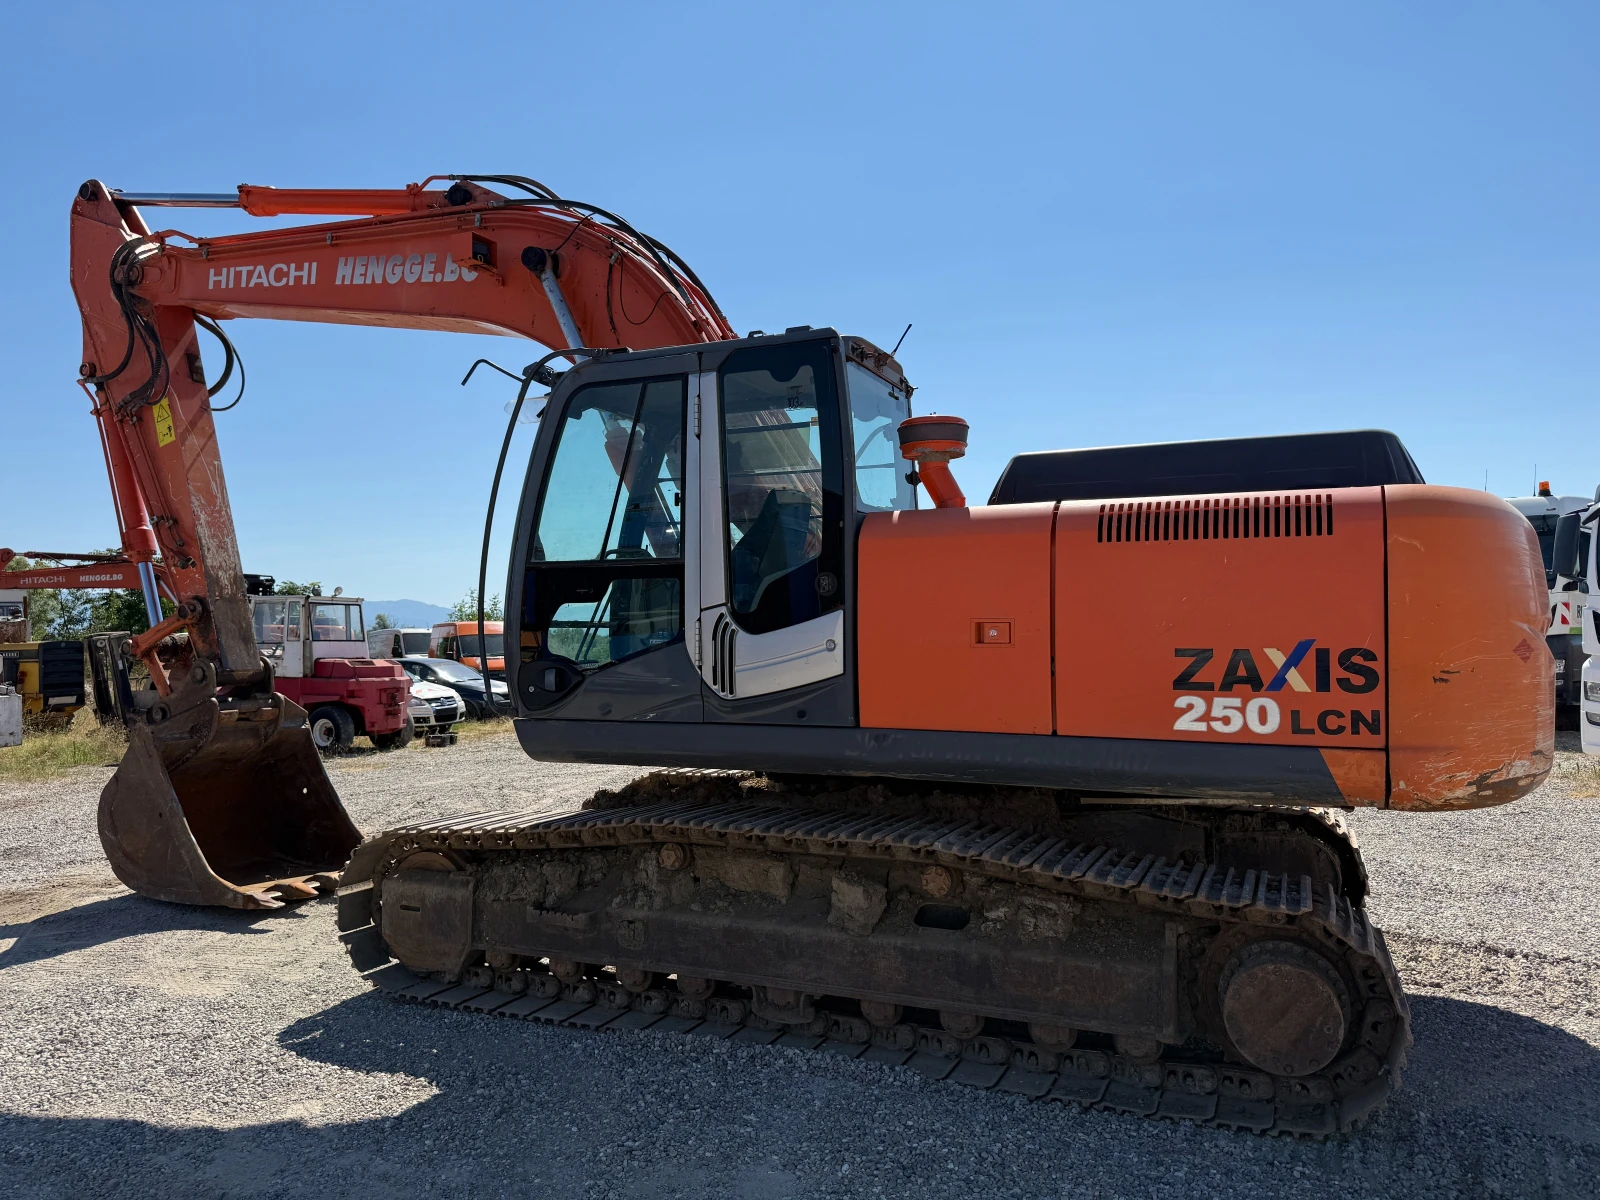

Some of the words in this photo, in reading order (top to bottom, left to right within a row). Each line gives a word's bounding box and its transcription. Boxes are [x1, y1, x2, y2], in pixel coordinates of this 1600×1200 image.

[208, 262, 317, 290] HITACHI
[20, 576, 66, 584] HITACHI
[79, 574, 123, 582] HENGGE.BG
[1172, 639, 1380, 694] ZAXIS
[1173, 695, 1281, 735] 250
[1291, 709, 1381, 736] LCN
